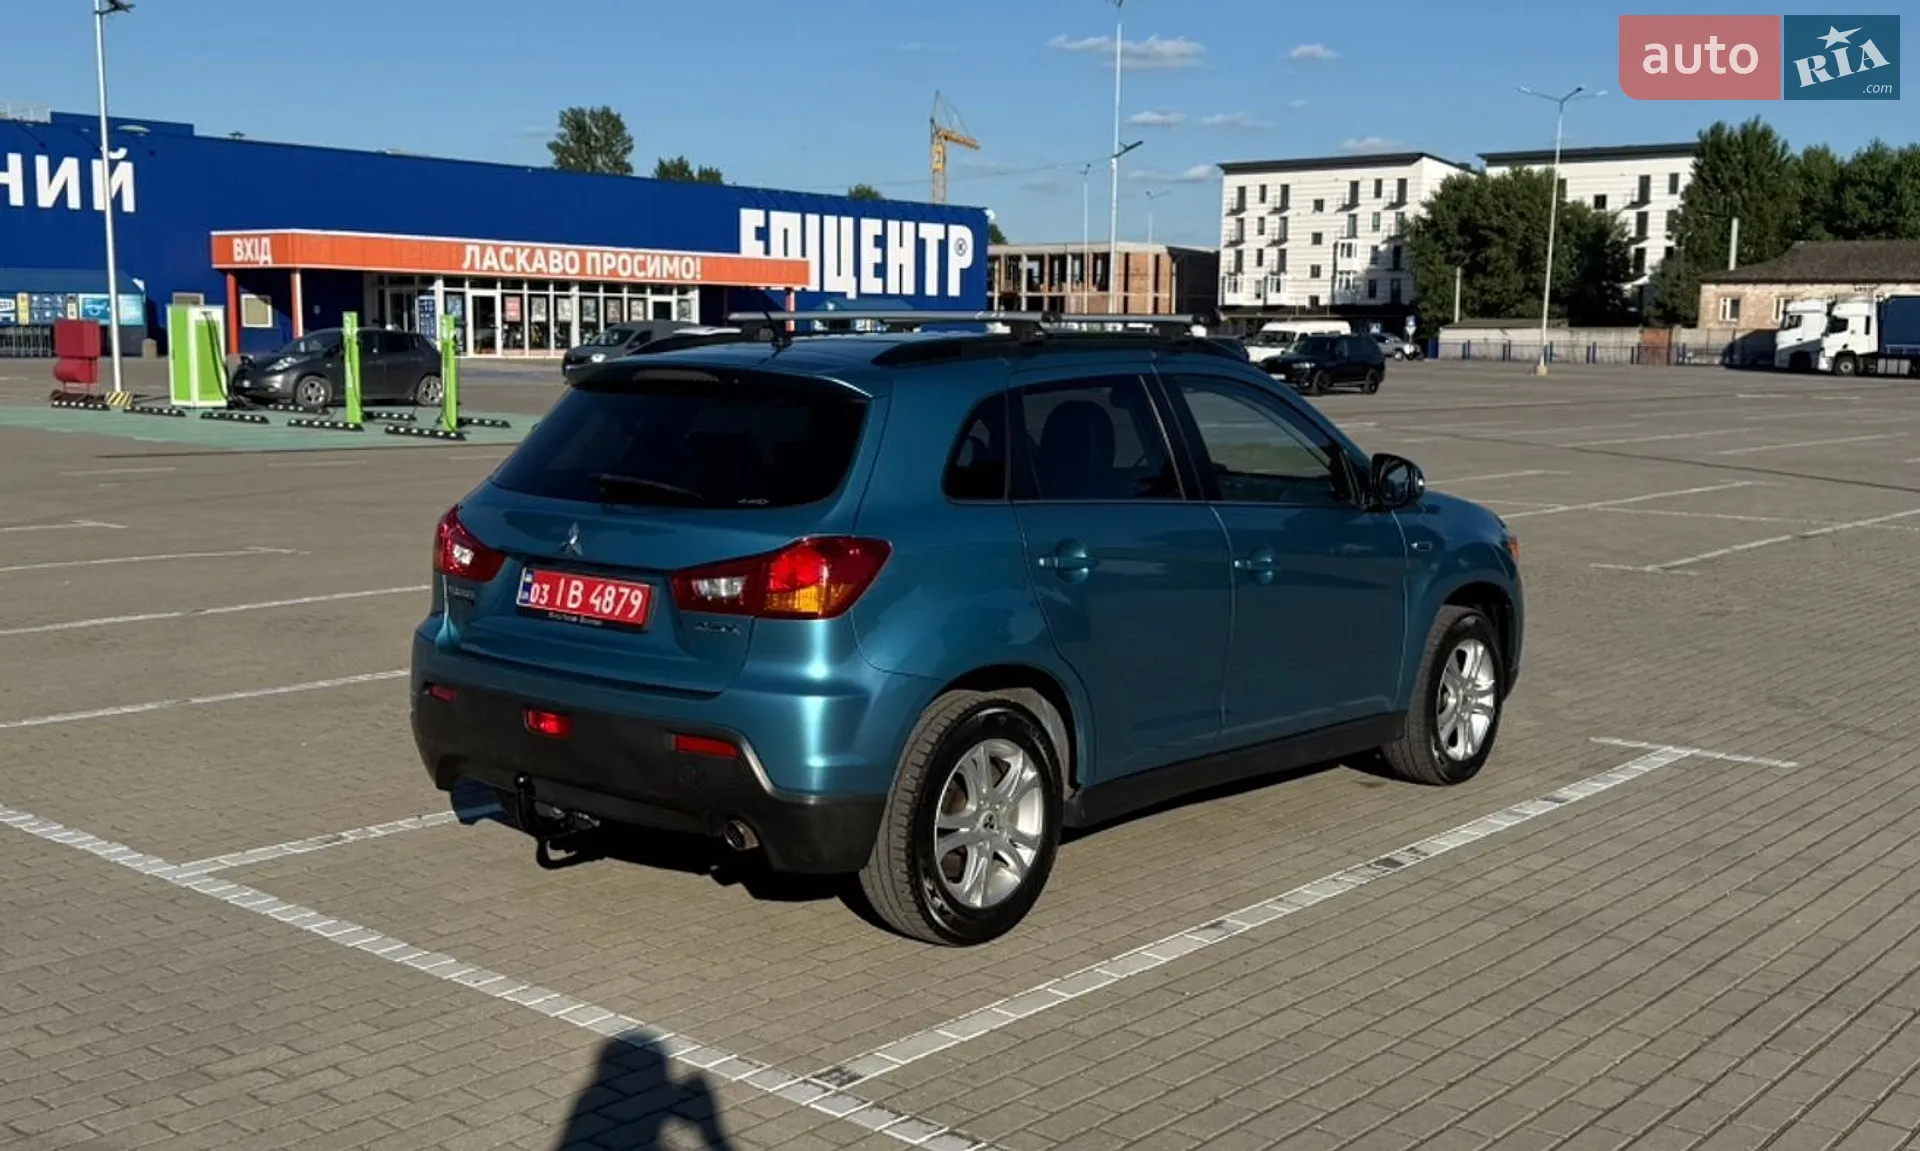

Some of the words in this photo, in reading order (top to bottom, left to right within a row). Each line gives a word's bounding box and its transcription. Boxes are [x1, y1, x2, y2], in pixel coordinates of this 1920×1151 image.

[232, 237, 272, 266] ВХІД
[461, 244, 580, 275] ЛАСКАВО
[586, 252, 702, 281] ПРОСИМО!
[530, 583, 550, 605] 03
[589, 584, 643, 618] 4879
